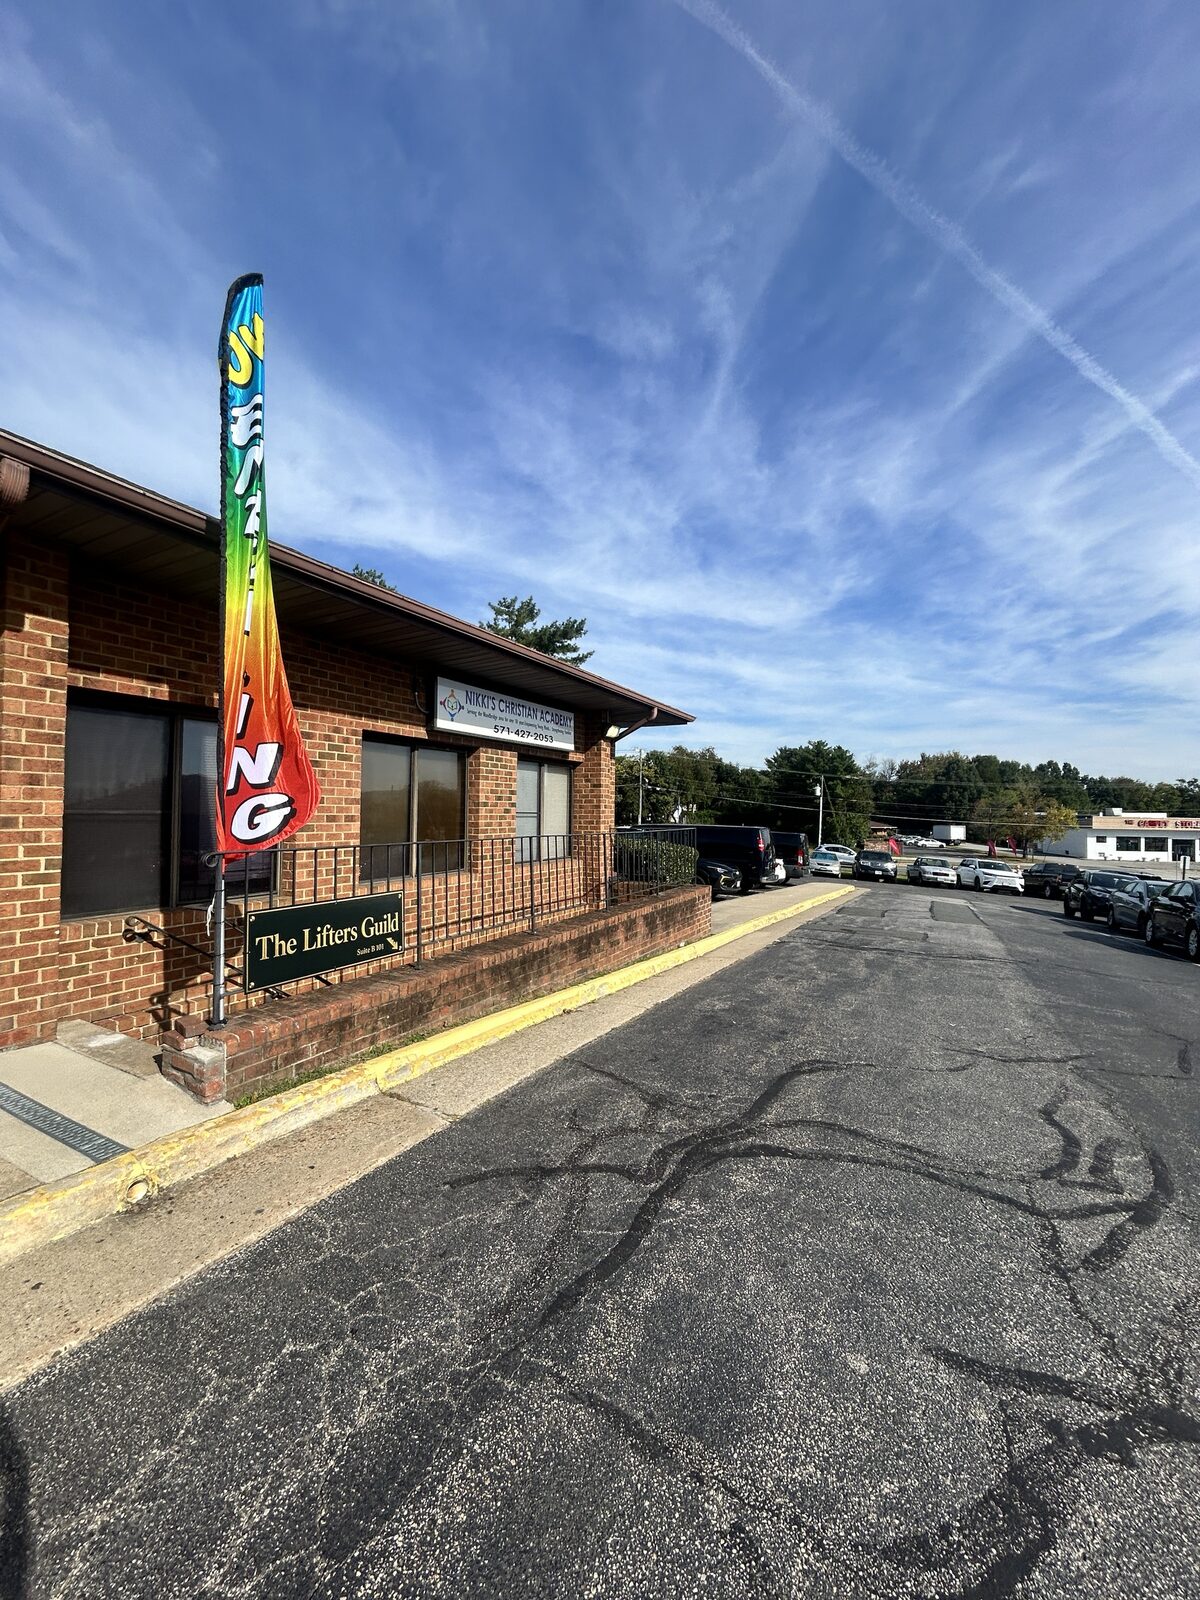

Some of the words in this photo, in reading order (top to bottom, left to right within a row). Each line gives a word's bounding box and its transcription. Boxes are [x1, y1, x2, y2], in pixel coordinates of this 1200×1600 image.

[465, 690, 496, 711] NIKKI'S
[498, 700, 538, 720] CHRISTIAN
[539, 711, 573, 729] ACADEMY
[493, 724, 554, 744] 571-427-2053
[255, 933, 298, 961] The
[302, 924, 358, 952] Lifters
[361, 911, 399, 939] Guild
[356, 946, 371, 956] Suite
[371, 945, 376, 953] B
[376, 943, 385, 952] 101
